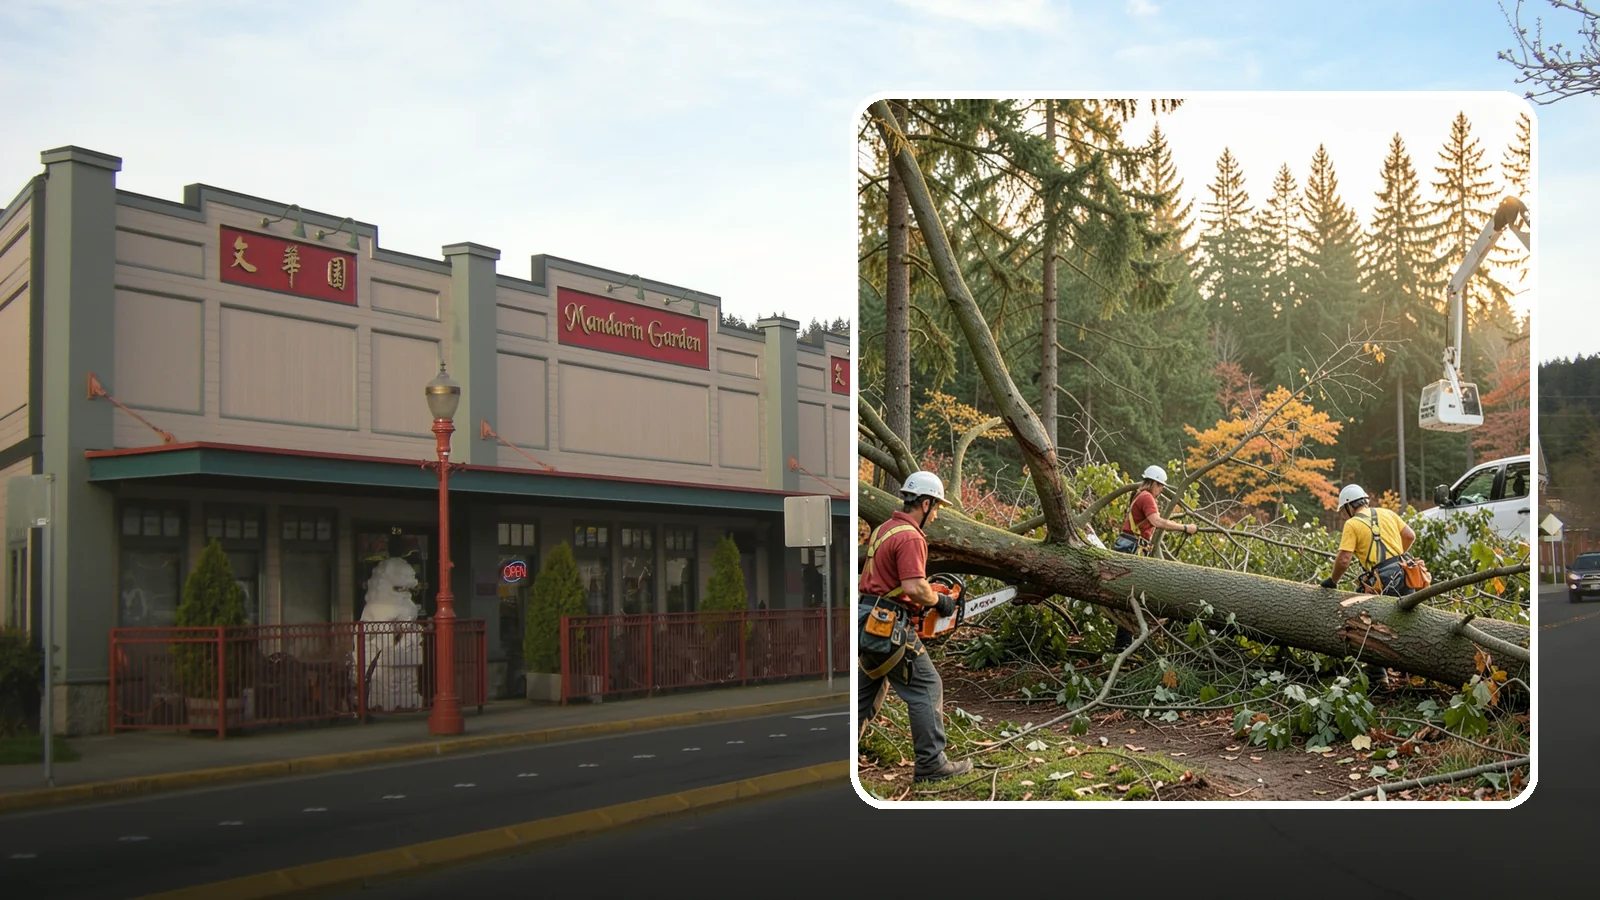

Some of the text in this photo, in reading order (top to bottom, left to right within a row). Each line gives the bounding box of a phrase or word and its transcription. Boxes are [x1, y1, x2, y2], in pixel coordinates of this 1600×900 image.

[231, 235, 346, 291] 文華園
[564, 302, 702, 352] Mandarin Garden
[503, 565, 527, 578] OPEN
